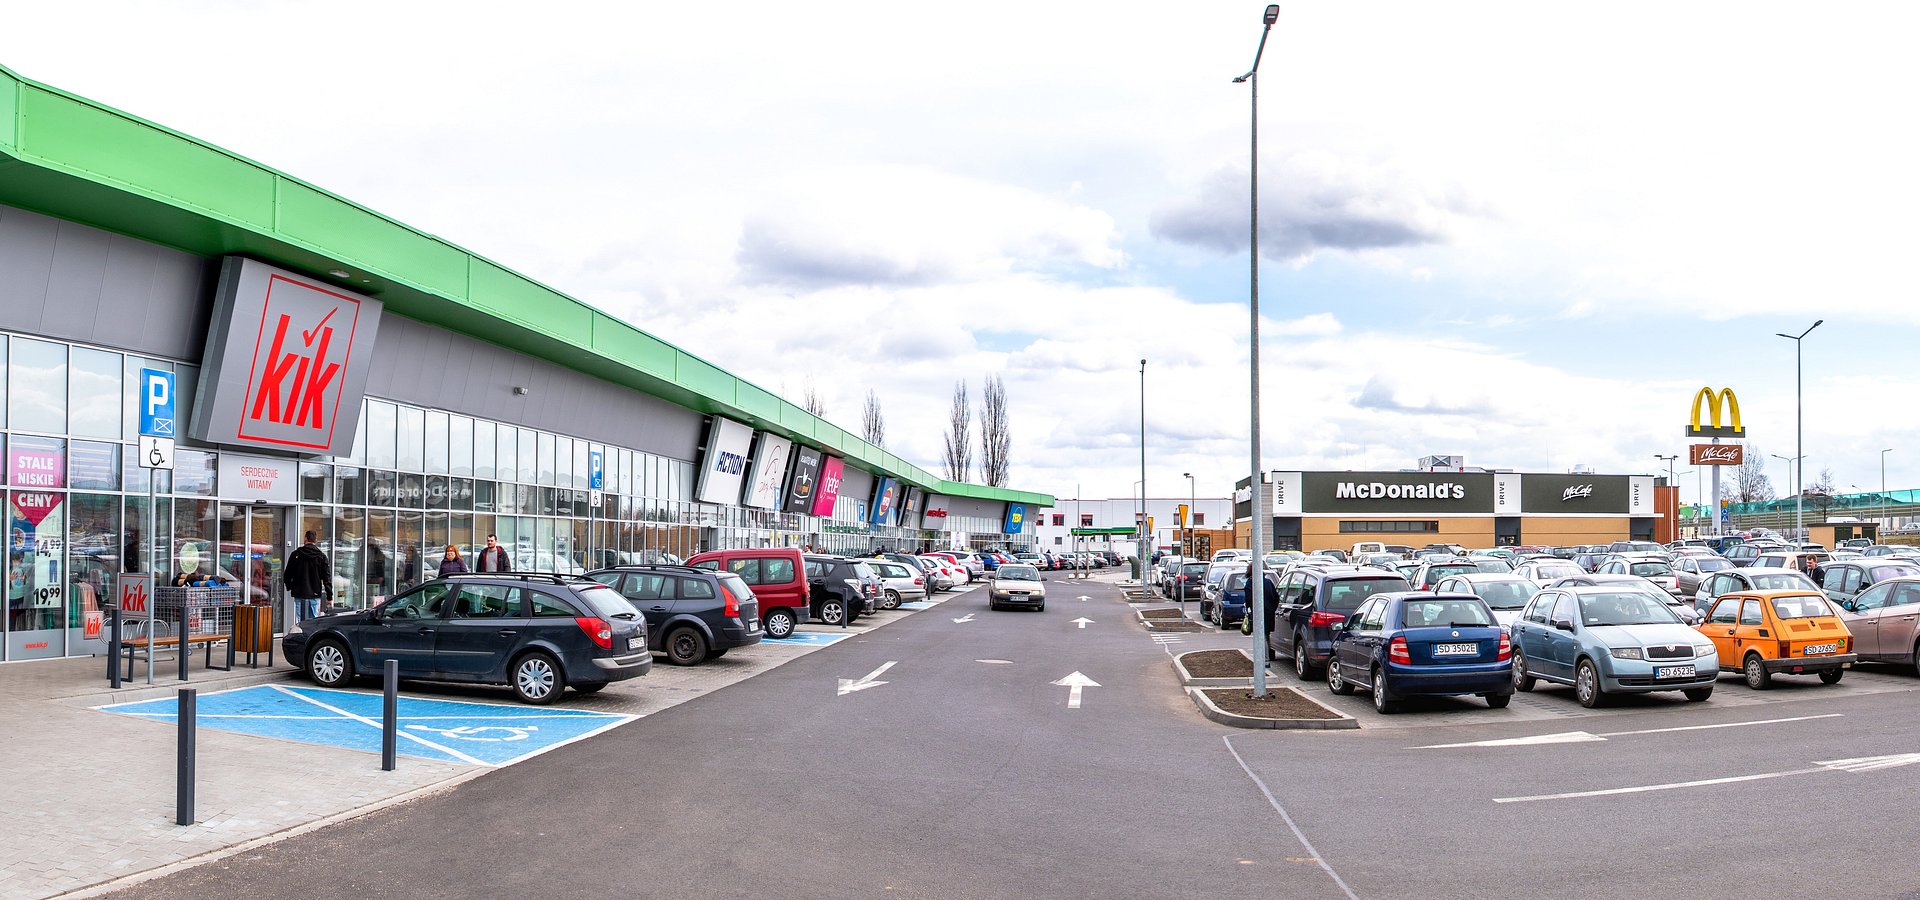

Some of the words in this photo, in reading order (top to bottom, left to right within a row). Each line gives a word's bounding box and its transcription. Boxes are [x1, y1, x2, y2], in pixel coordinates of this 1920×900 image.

[251, 307, 341, 430] kik
[148, 374, 169, 416] P
[240, 466, 279, 479] SERDECZNIE
[593, 455, 600, 477] P
[716, 451, 745, 476] ACTION
[17, 473, 54, 486] NISKIE
[247, 479, 273, 490] WITAMY
[1336, 482, 1465, 499] McDonald's
[17, 493, 54, 508] CENY
[33, 587, 61, 606] 19,99
[121, 579, 148, 612] kik
[86, 614, 101, 635] kik
[1439, 645, 1450, 653] SD
[1452, 644, 1476, 653] 3502E
[1660, 668, 1671, 677] SD
[1672, 666, 1695, 675] 6523E
